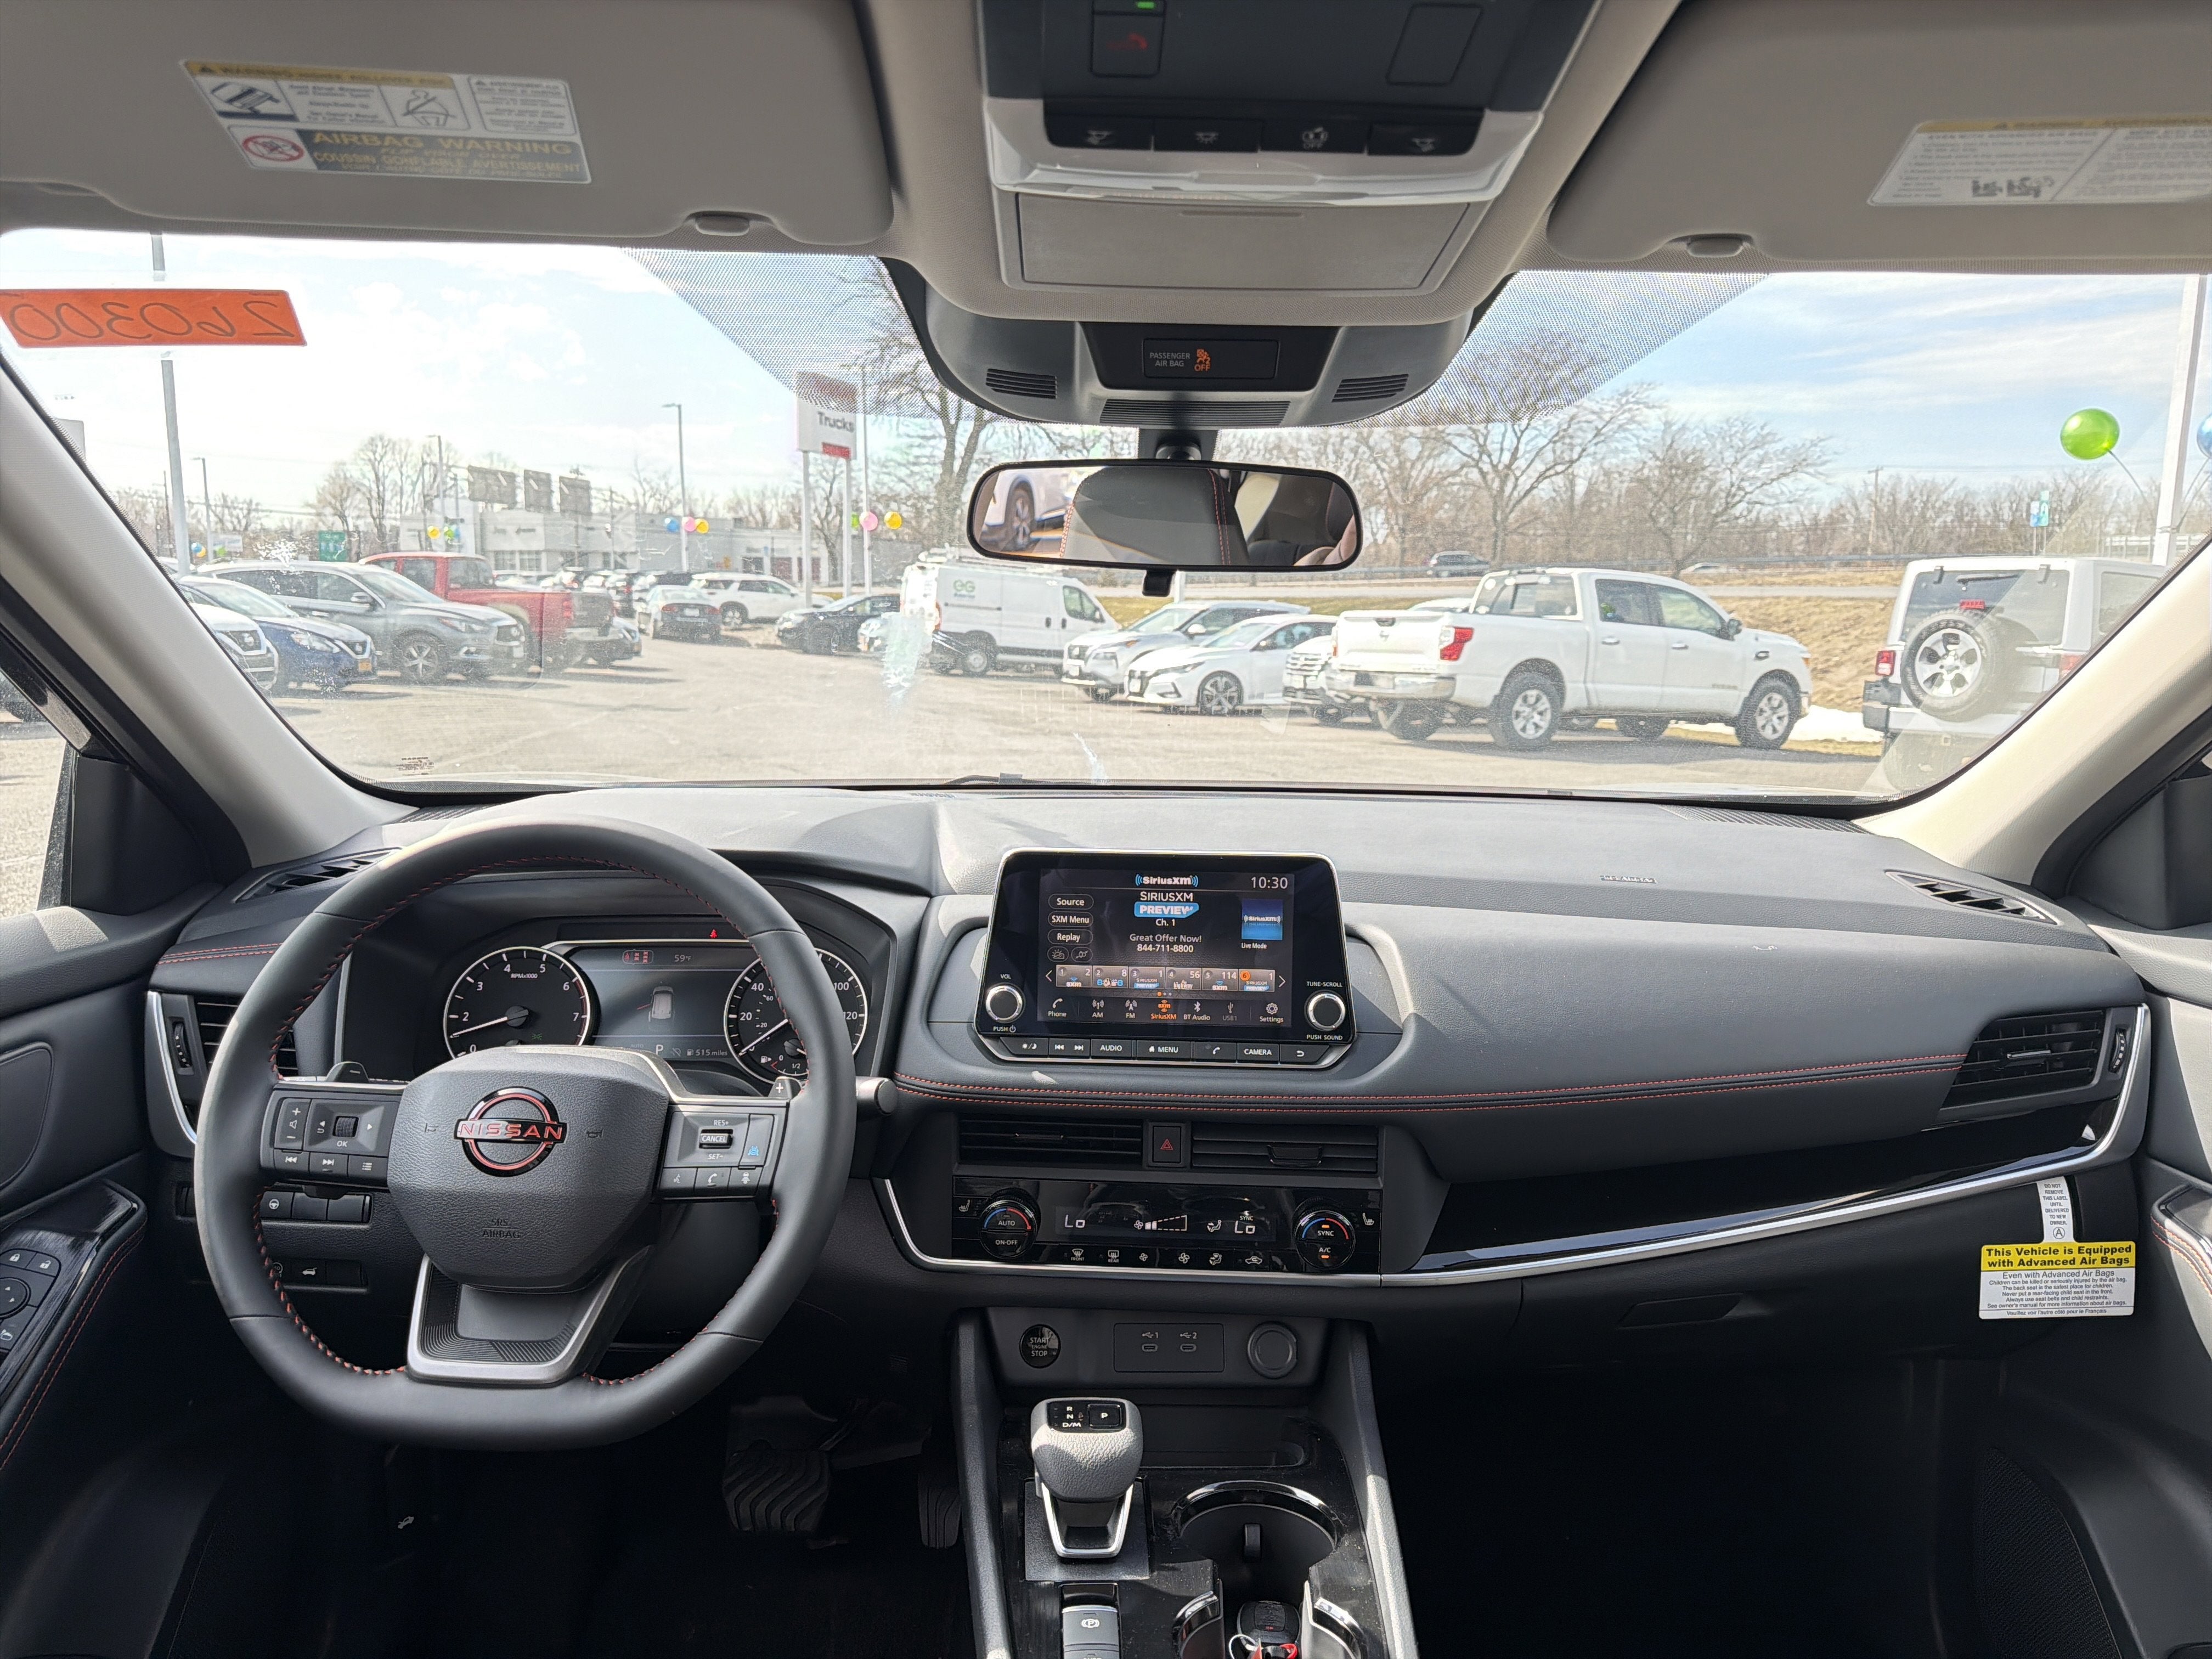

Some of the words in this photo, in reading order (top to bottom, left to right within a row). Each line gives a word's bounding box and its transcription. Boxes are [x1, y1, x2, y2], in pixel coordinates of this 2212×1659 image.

[314, 132, 423, 148] AIRBAG
[439, 138, 572, 155] WARNING
[817, 411, 854, 433] Trucks
[1251, 877, 1288, 889] 10:30
[1140, 891, 1193, 901] SIRIUSXM
[1139, 905, 1193, 915] PREVIEW
[1057, 933, 1080, 943] Replay
[1137, 944, 1194, 952] 844-711-8800
[504, 964, 511, 973] 4
[540, 964, 546, 973] 5
[1189, 970, 1200, 979] 56
[477, 982, 483, 991] 3
[563, 982, 569, 991] 6
[751, 983, 764, 991] 40
[834, 983, 849, 991] 100
[462, 1012, 469, 1021] 2
[573, 1013, 579, 1021] 7
[740, 1012, 752, 1020] 20
[1260, 1015, 1284, 1024] Settings
[470, 1045, 476, 1053] 0
[656, 1044, 664, 1054] P
[460, 1123, 562, 1139] NISSAN
[482, 1229, 520, 1239] AIRBAG
[1986, 1248, 2011, 1256] This
[2015, 1246, 2059, 1256] Vehicle
[2063, 1246, 2073, 1255] is
[2078, 1245, 2131, 1256] Equipped
[1987, 1259, 2013, 1267] with
[2017, 1257, 2076, 1267] Advanced
[2080, 1257, 2097, 1265] Air
[2101, 1256, 2130, 1266] Bags
